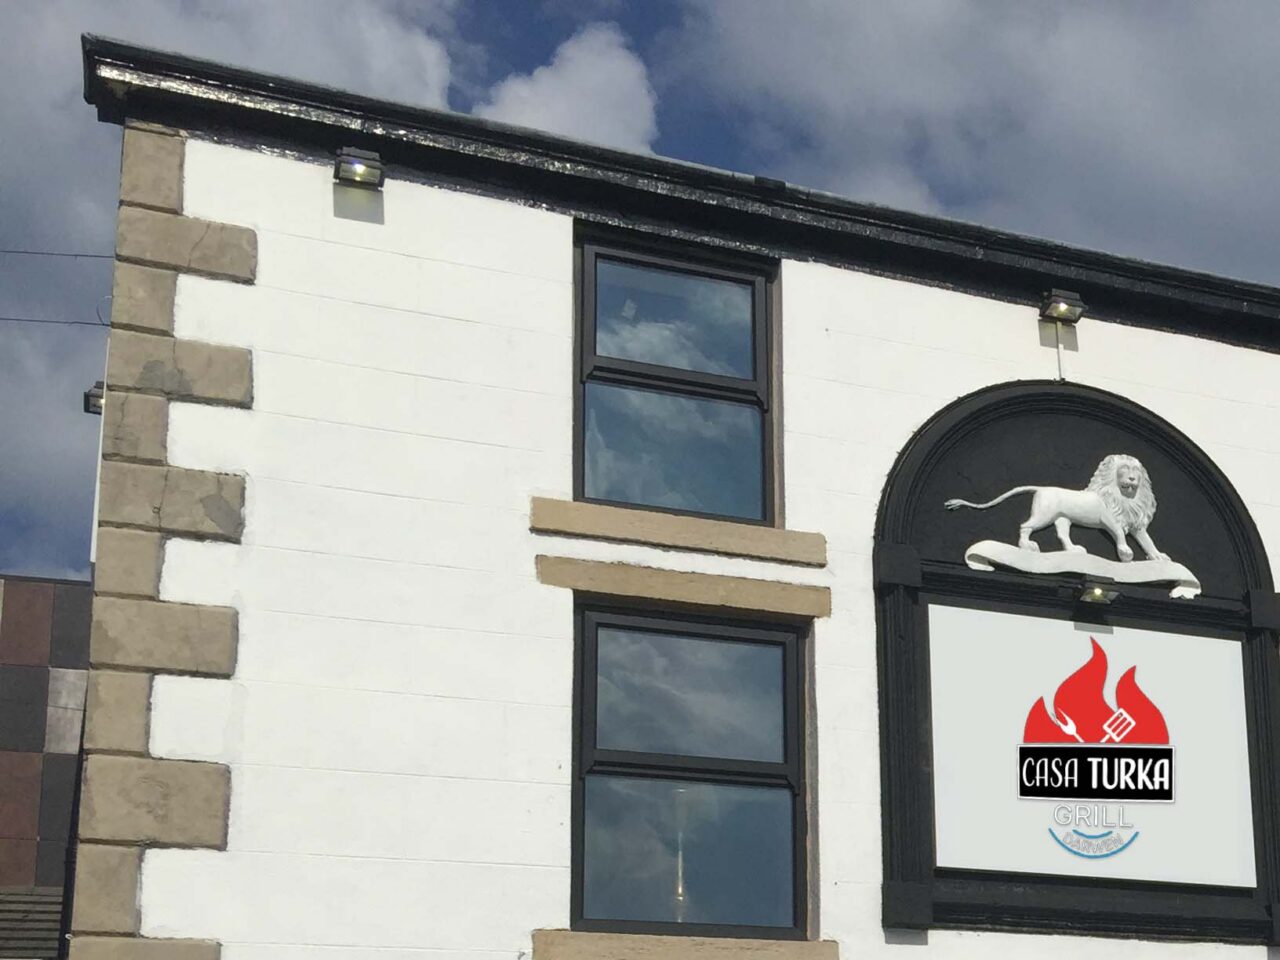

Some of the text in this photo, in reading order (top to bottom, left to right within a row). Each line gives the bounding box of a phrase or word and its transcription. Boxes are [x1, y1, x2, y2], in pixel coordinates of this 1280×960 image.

[1022, 757, 1170, 790] CASA TURKA
[1054, 804, 1134, 828] GRILL
